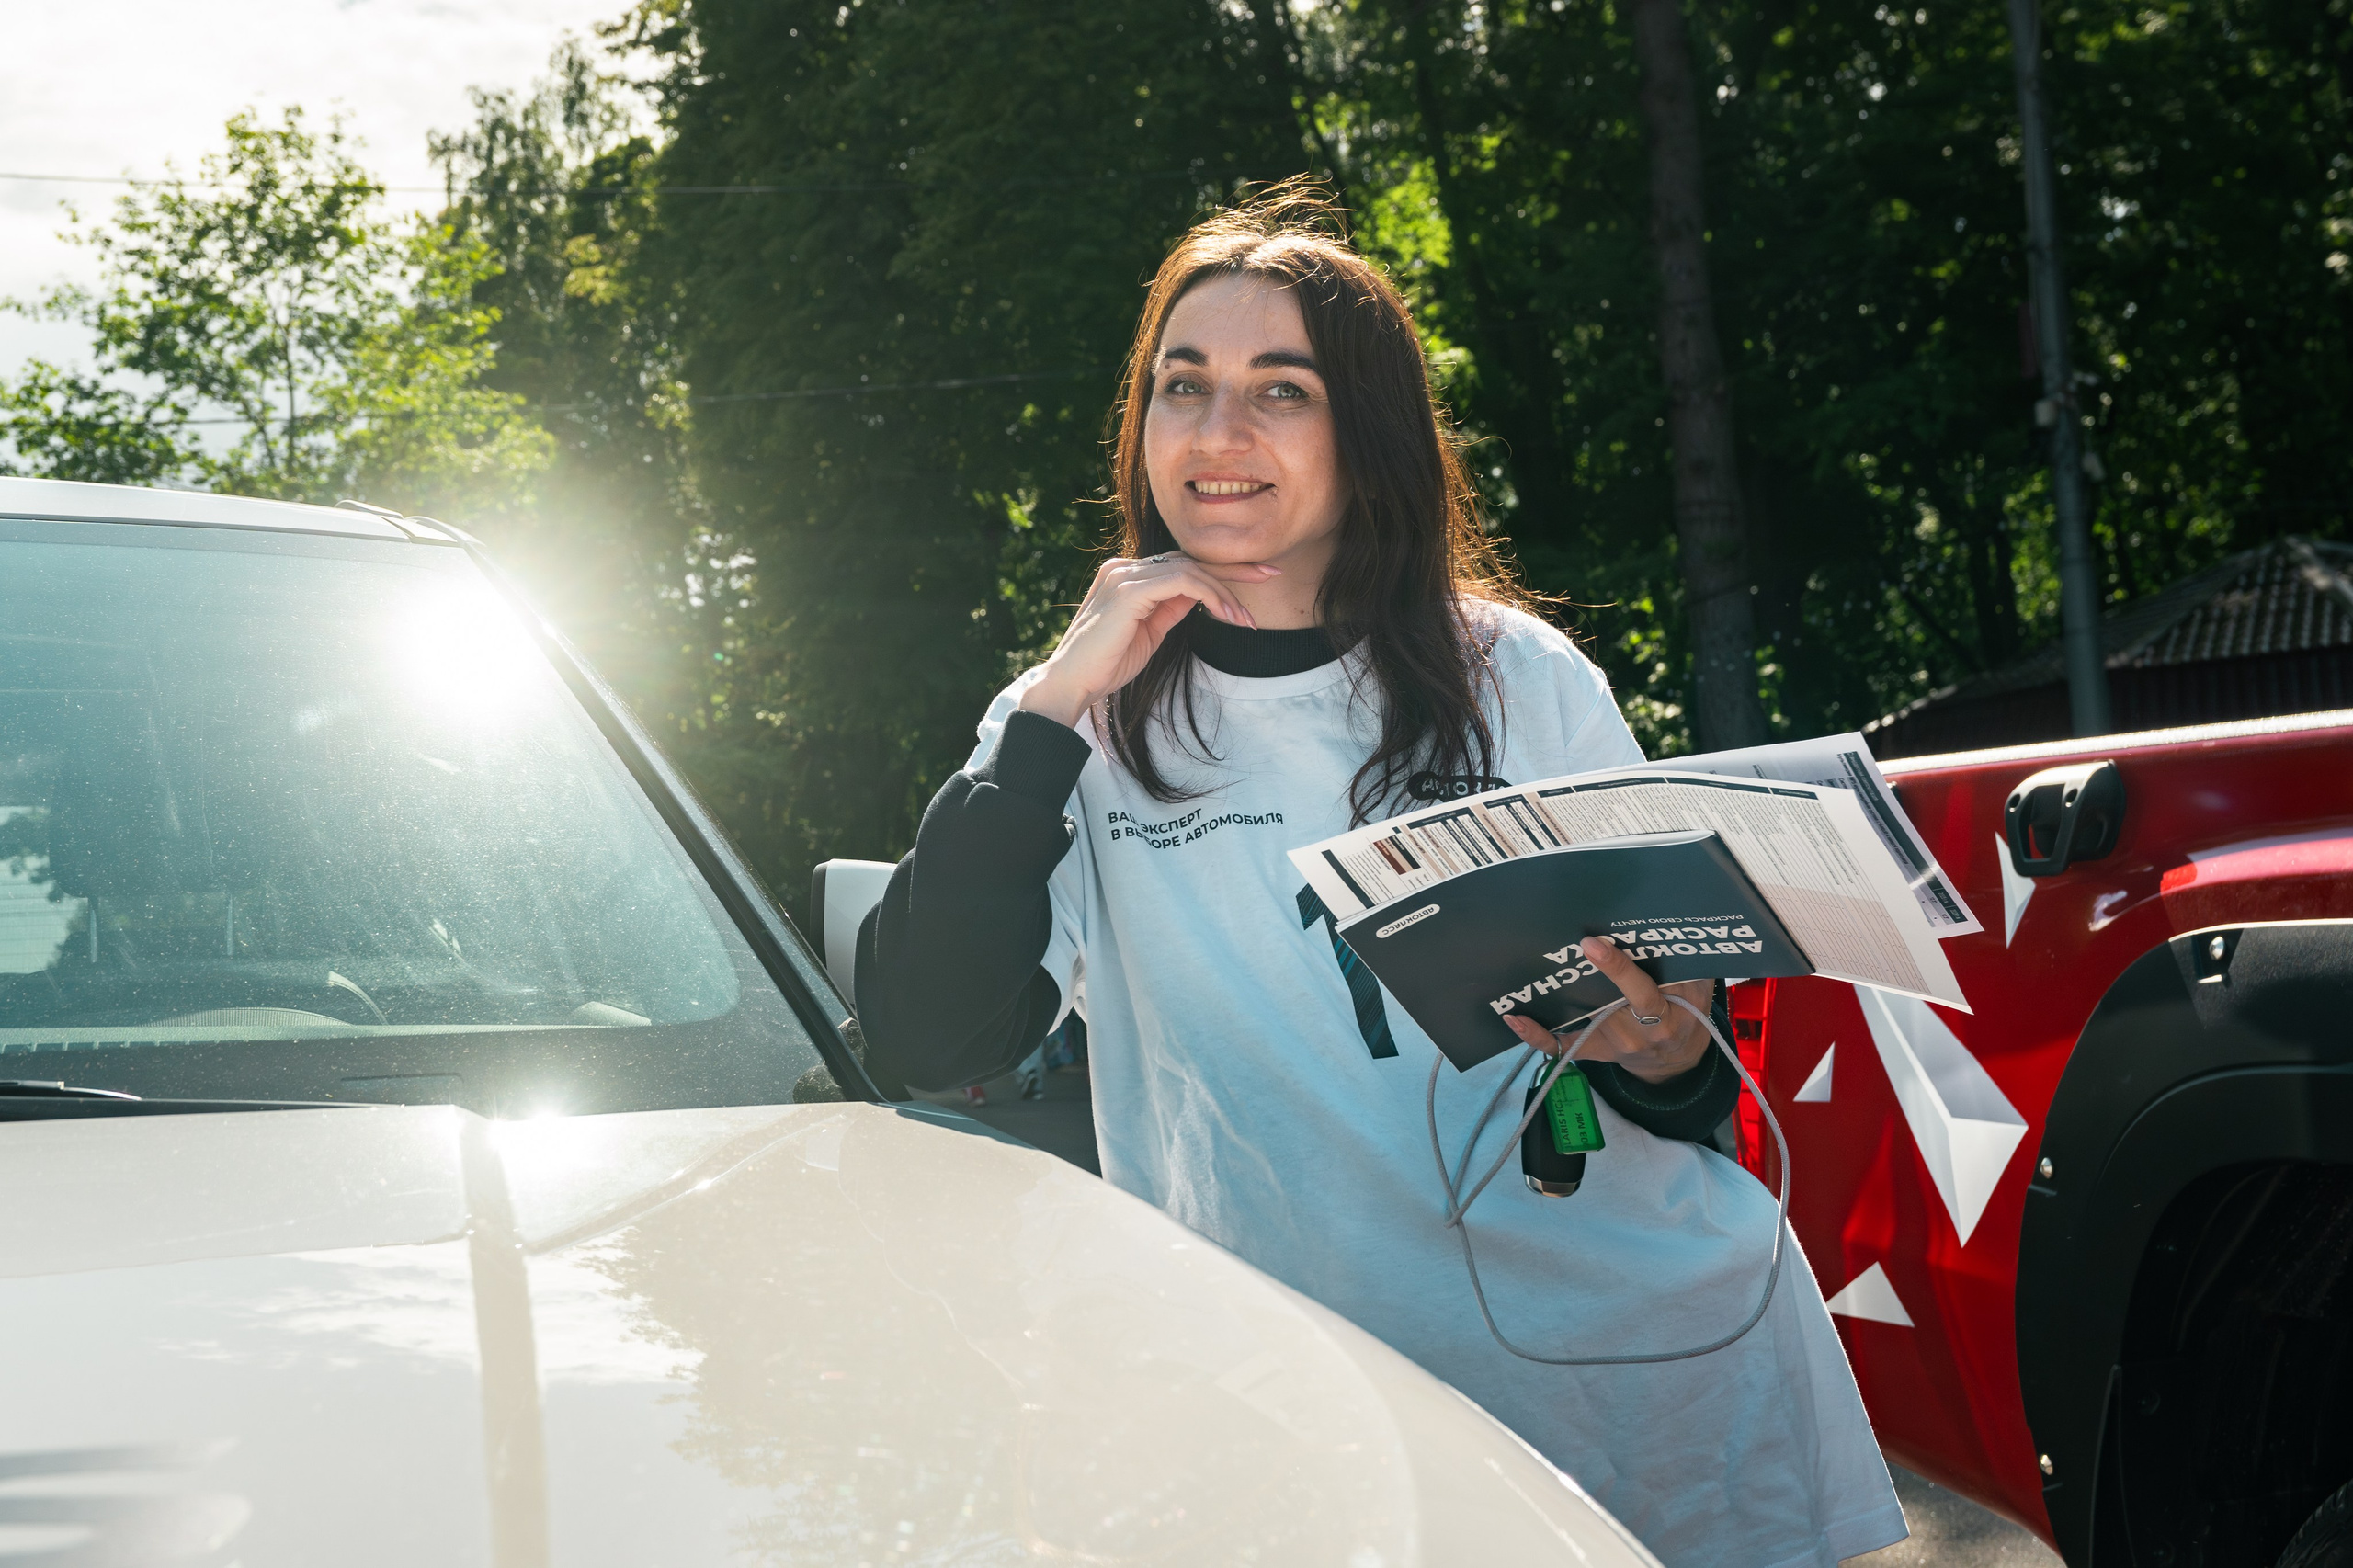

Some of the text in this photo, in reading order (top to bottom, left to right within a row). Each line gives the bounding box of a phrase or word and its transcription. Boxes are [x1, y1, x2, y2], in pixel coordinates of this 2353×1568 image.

[1110, 828, 1121, 841] В
[1184, 812, 1284, 845] АВТОМОБИЛЯ
[1139, 807, 1202, 835] ЭКСПЕРТ
[1381, 906, 1435, 936] АВТОКЛАСС
[1610, 918, 1647, 928] МЕЧТУ
[1684, 914, 1745, 923] РАСКРАСЬ
[1489, 940, 1763, 1016] АВТОКЛССНАЯ
[1557, 1118, 1572, 1148] LARIS
